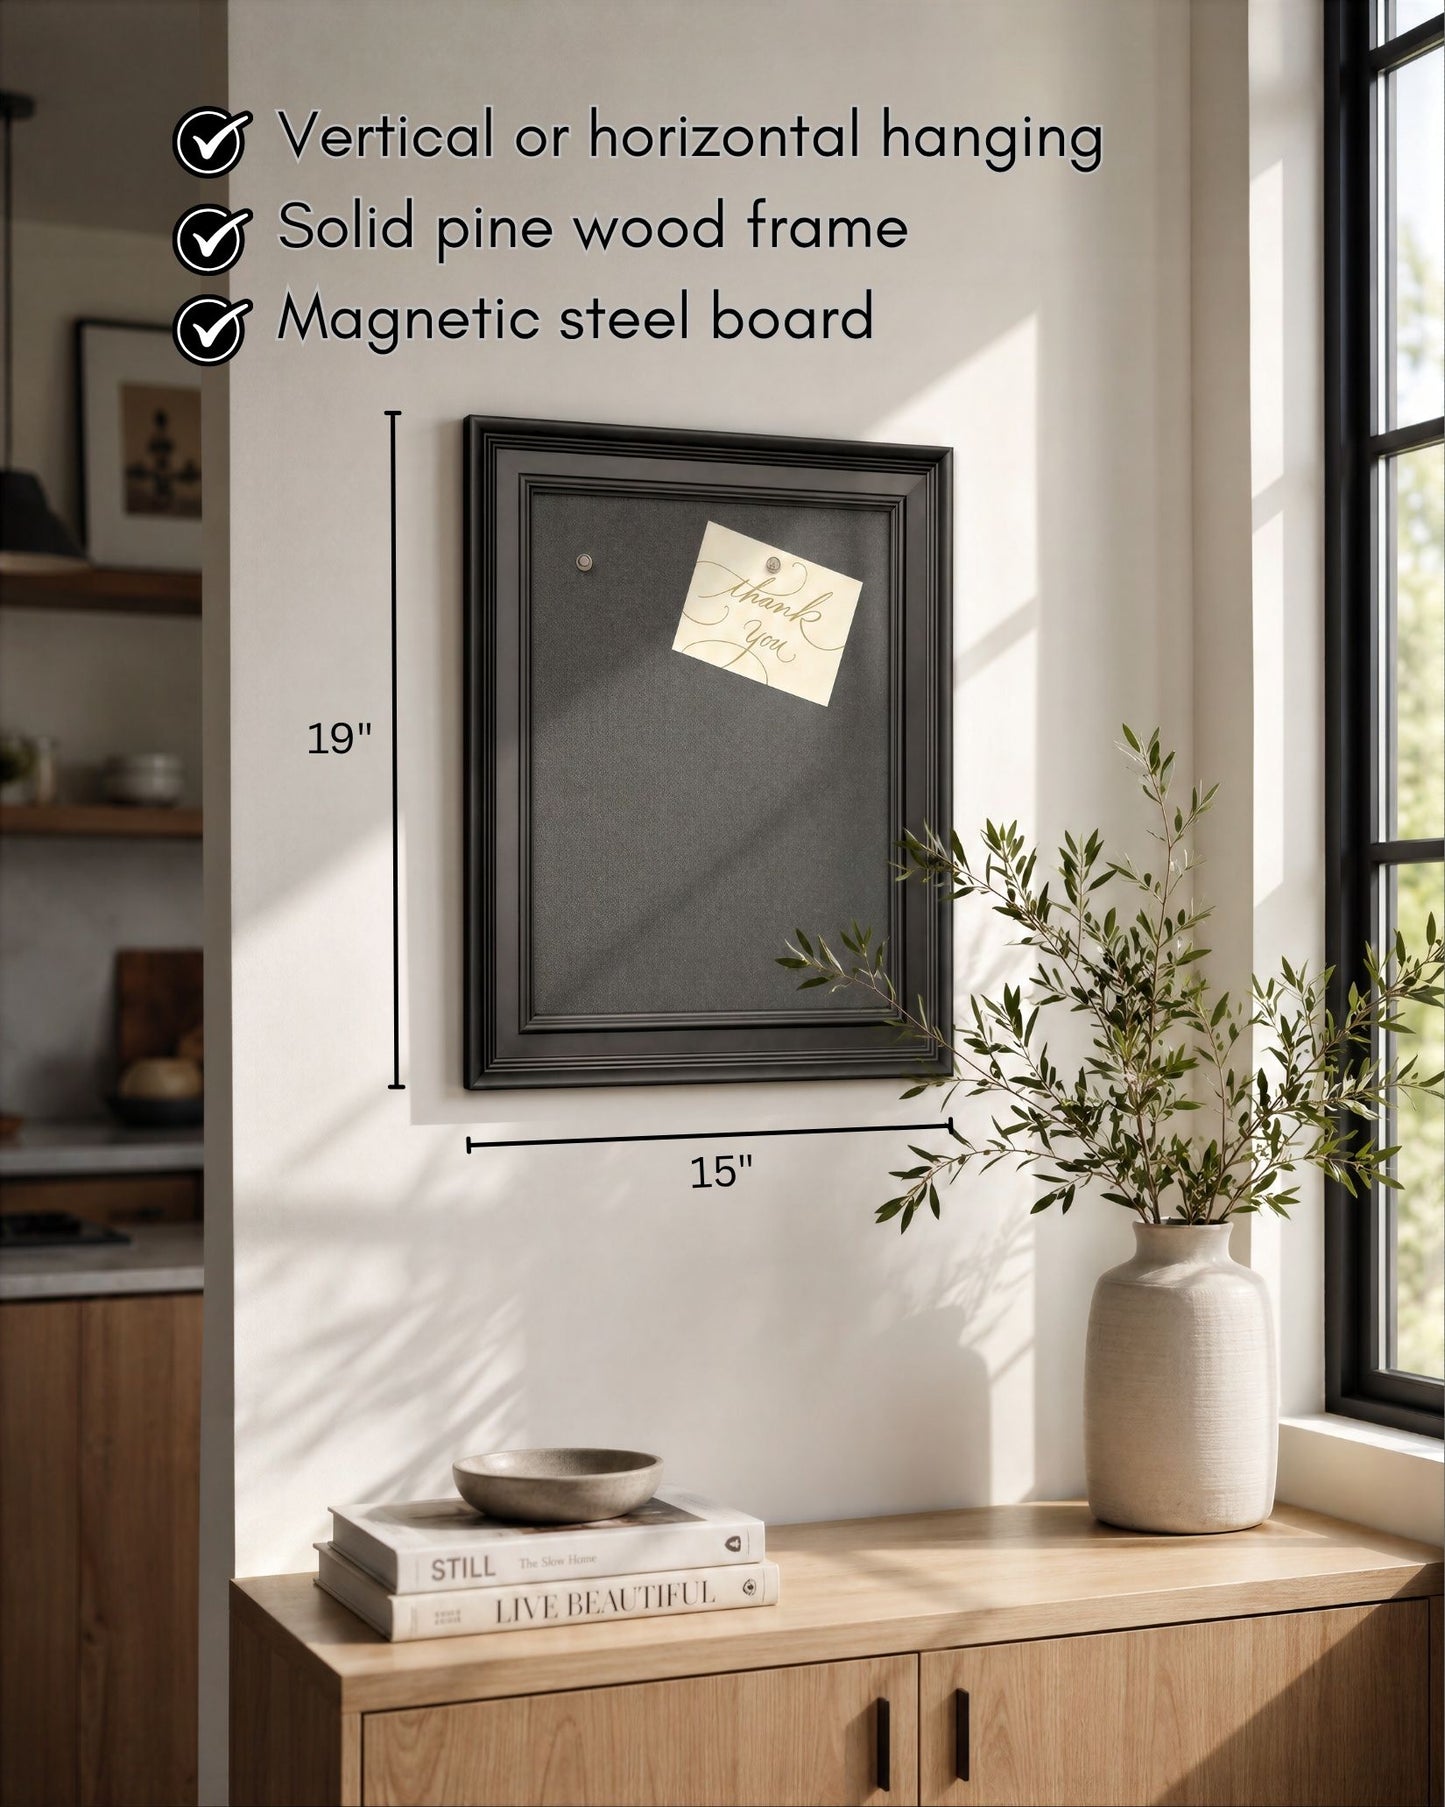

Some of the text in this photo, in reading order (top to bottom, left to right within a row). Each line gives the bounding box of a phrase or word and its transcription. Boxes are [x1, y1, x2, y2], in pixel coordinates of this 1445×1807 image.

[724, 576, 834, 624] thank
[740, 618, 796, 664] you
[431, 1555, 496, 1581] STILL
[519, 1557, 538, 1569] The
[495, 1594, 559, 1624] LIVE
[567, 1579, 717, 1617] BEAUTIFUL
